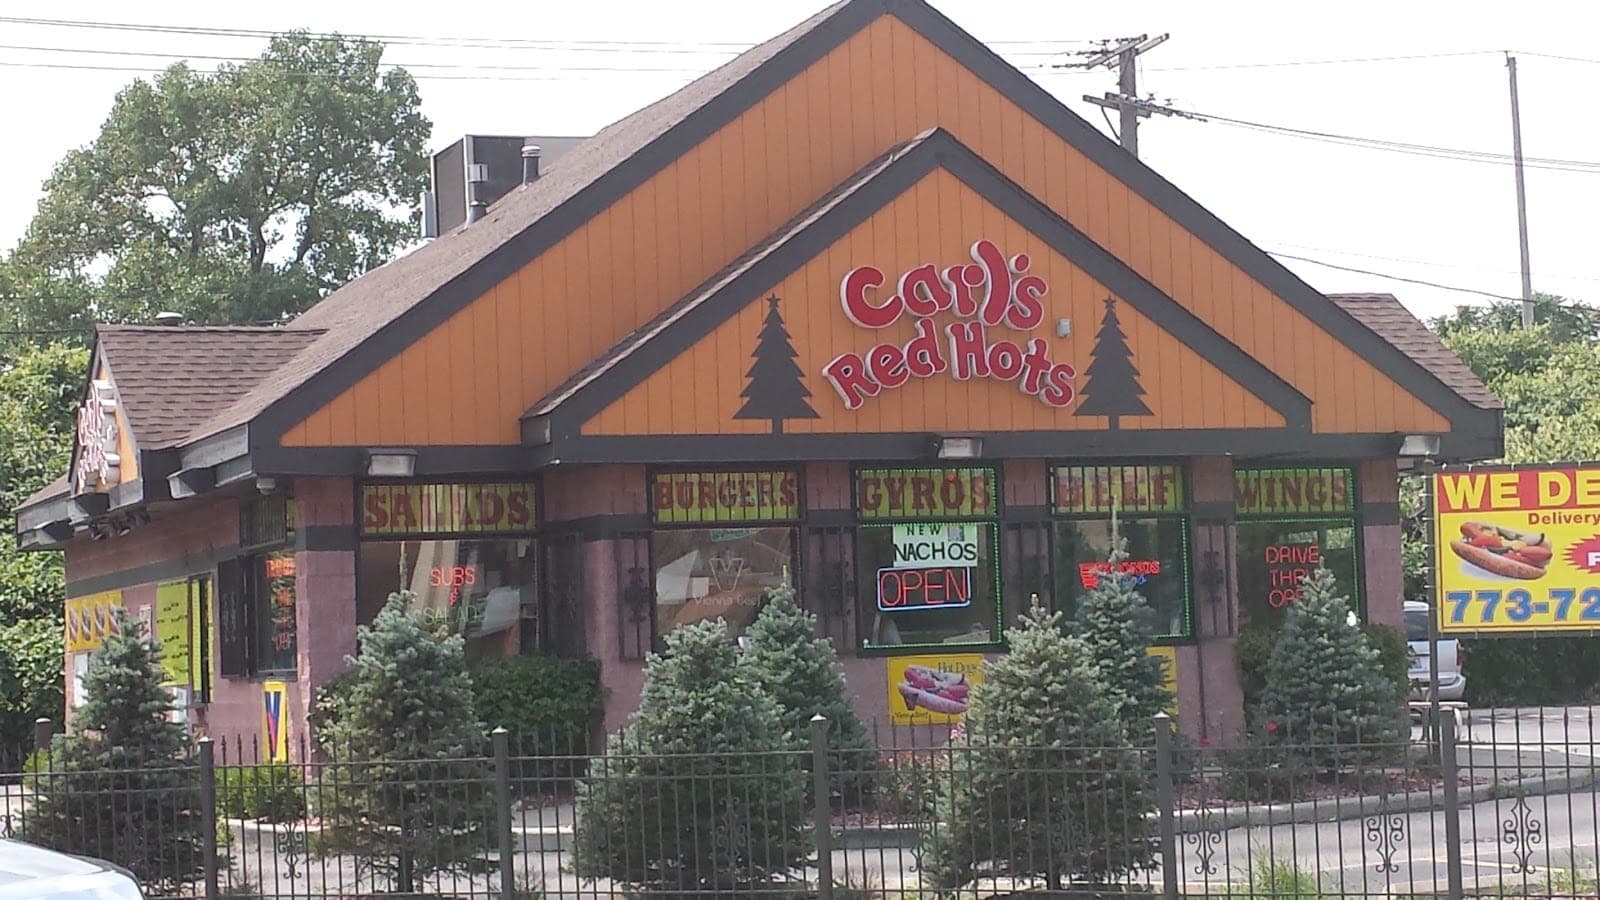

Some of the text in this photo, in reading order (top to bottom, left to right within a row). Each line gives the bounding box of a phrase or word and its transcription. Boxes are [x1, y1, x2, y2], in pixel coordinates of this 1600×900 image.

[822, 317, 1077, 410] Red Hots
[656, 478, 797, 510] BURGERS
[862, 475, 990, 511] GYROS
[1235, 474, 1349, 509] WINGS
[1441, 470, 1600, 510] WE DE
[906, 525, 942, 537] NEW
[1528, 511, 1600, 526] Delivery
[893, 541, 978, 562] NACHOS
[1265, 545, 1320, 565] DRIVE
[430, 566, 476, 587] SUBS
[880, 568, 967, 607] OPEN
[1445, 586, 1600, 624] 773-72
